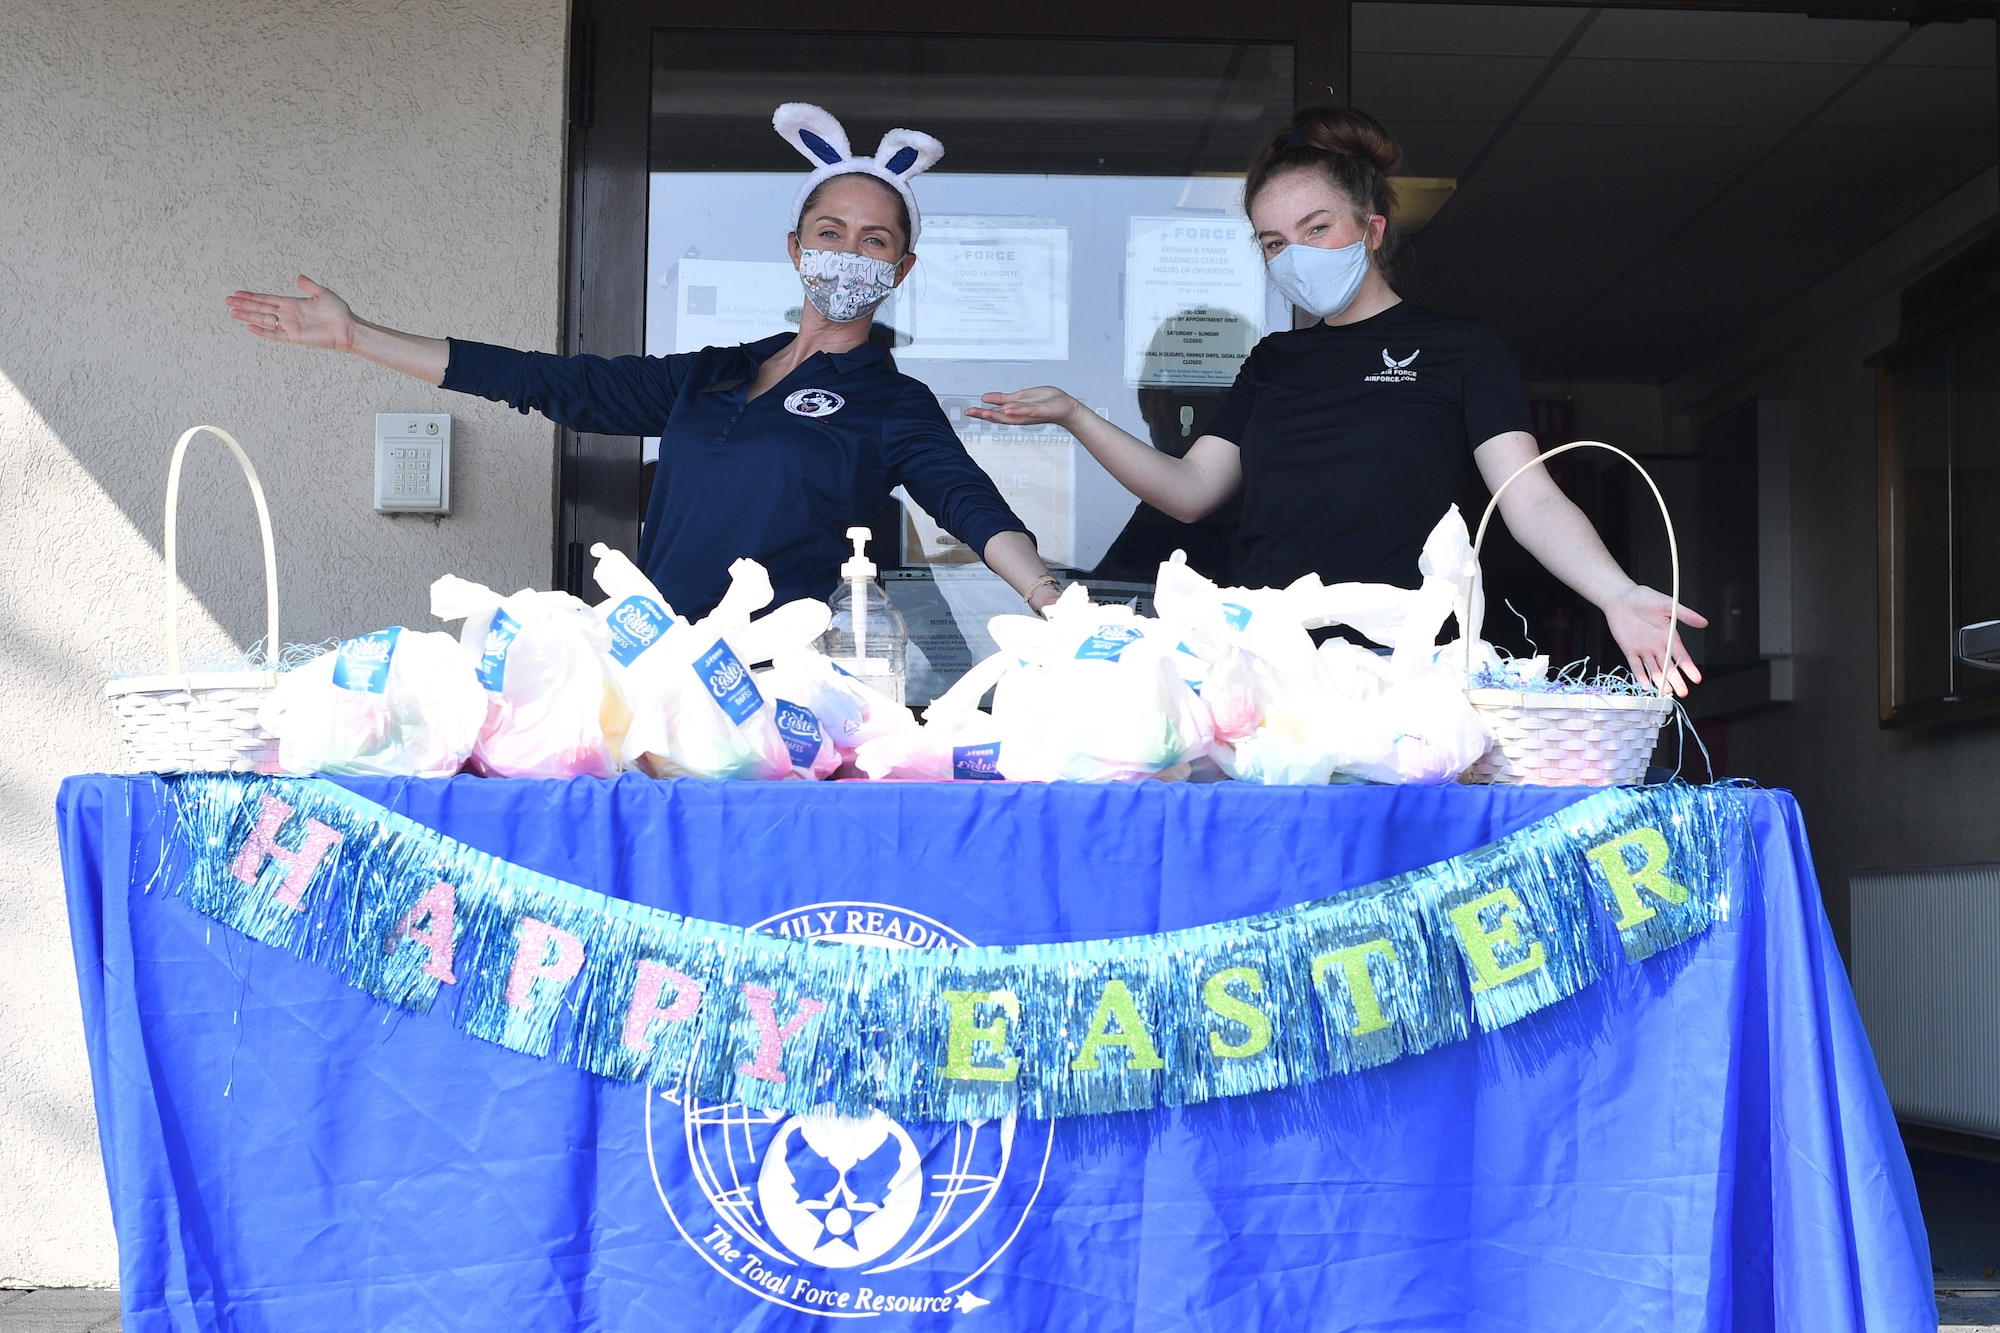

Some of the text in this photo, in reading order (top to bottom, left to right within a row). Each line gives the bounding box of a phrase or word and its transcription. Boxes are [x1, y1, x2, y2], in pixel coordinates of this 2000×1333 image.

[1174, 227, 1236, 240] FORCE
[1161, 246, 1228, 255] AIRMAN & FAMILY
[965, 251, 1015, 261] FORCE
[1159, 256, 1229, 265] READINESS CENTER
[989, 270, 1020, 278] UPDATE
[1153, 265, 1235, 275] HOURS OF OPERATION
[720, 306, 732, 314] VA
[733, 306, 796, 317] Representative
[717, 317, 754, 328] currently
[1393, 369, 1417, 377] FORCE
[709, 657, 747, 697] Easter
[227, 792, 1690, 1083] HAPPY EASTER
[703, 1222, 953, 1314] The Total Force Resource
